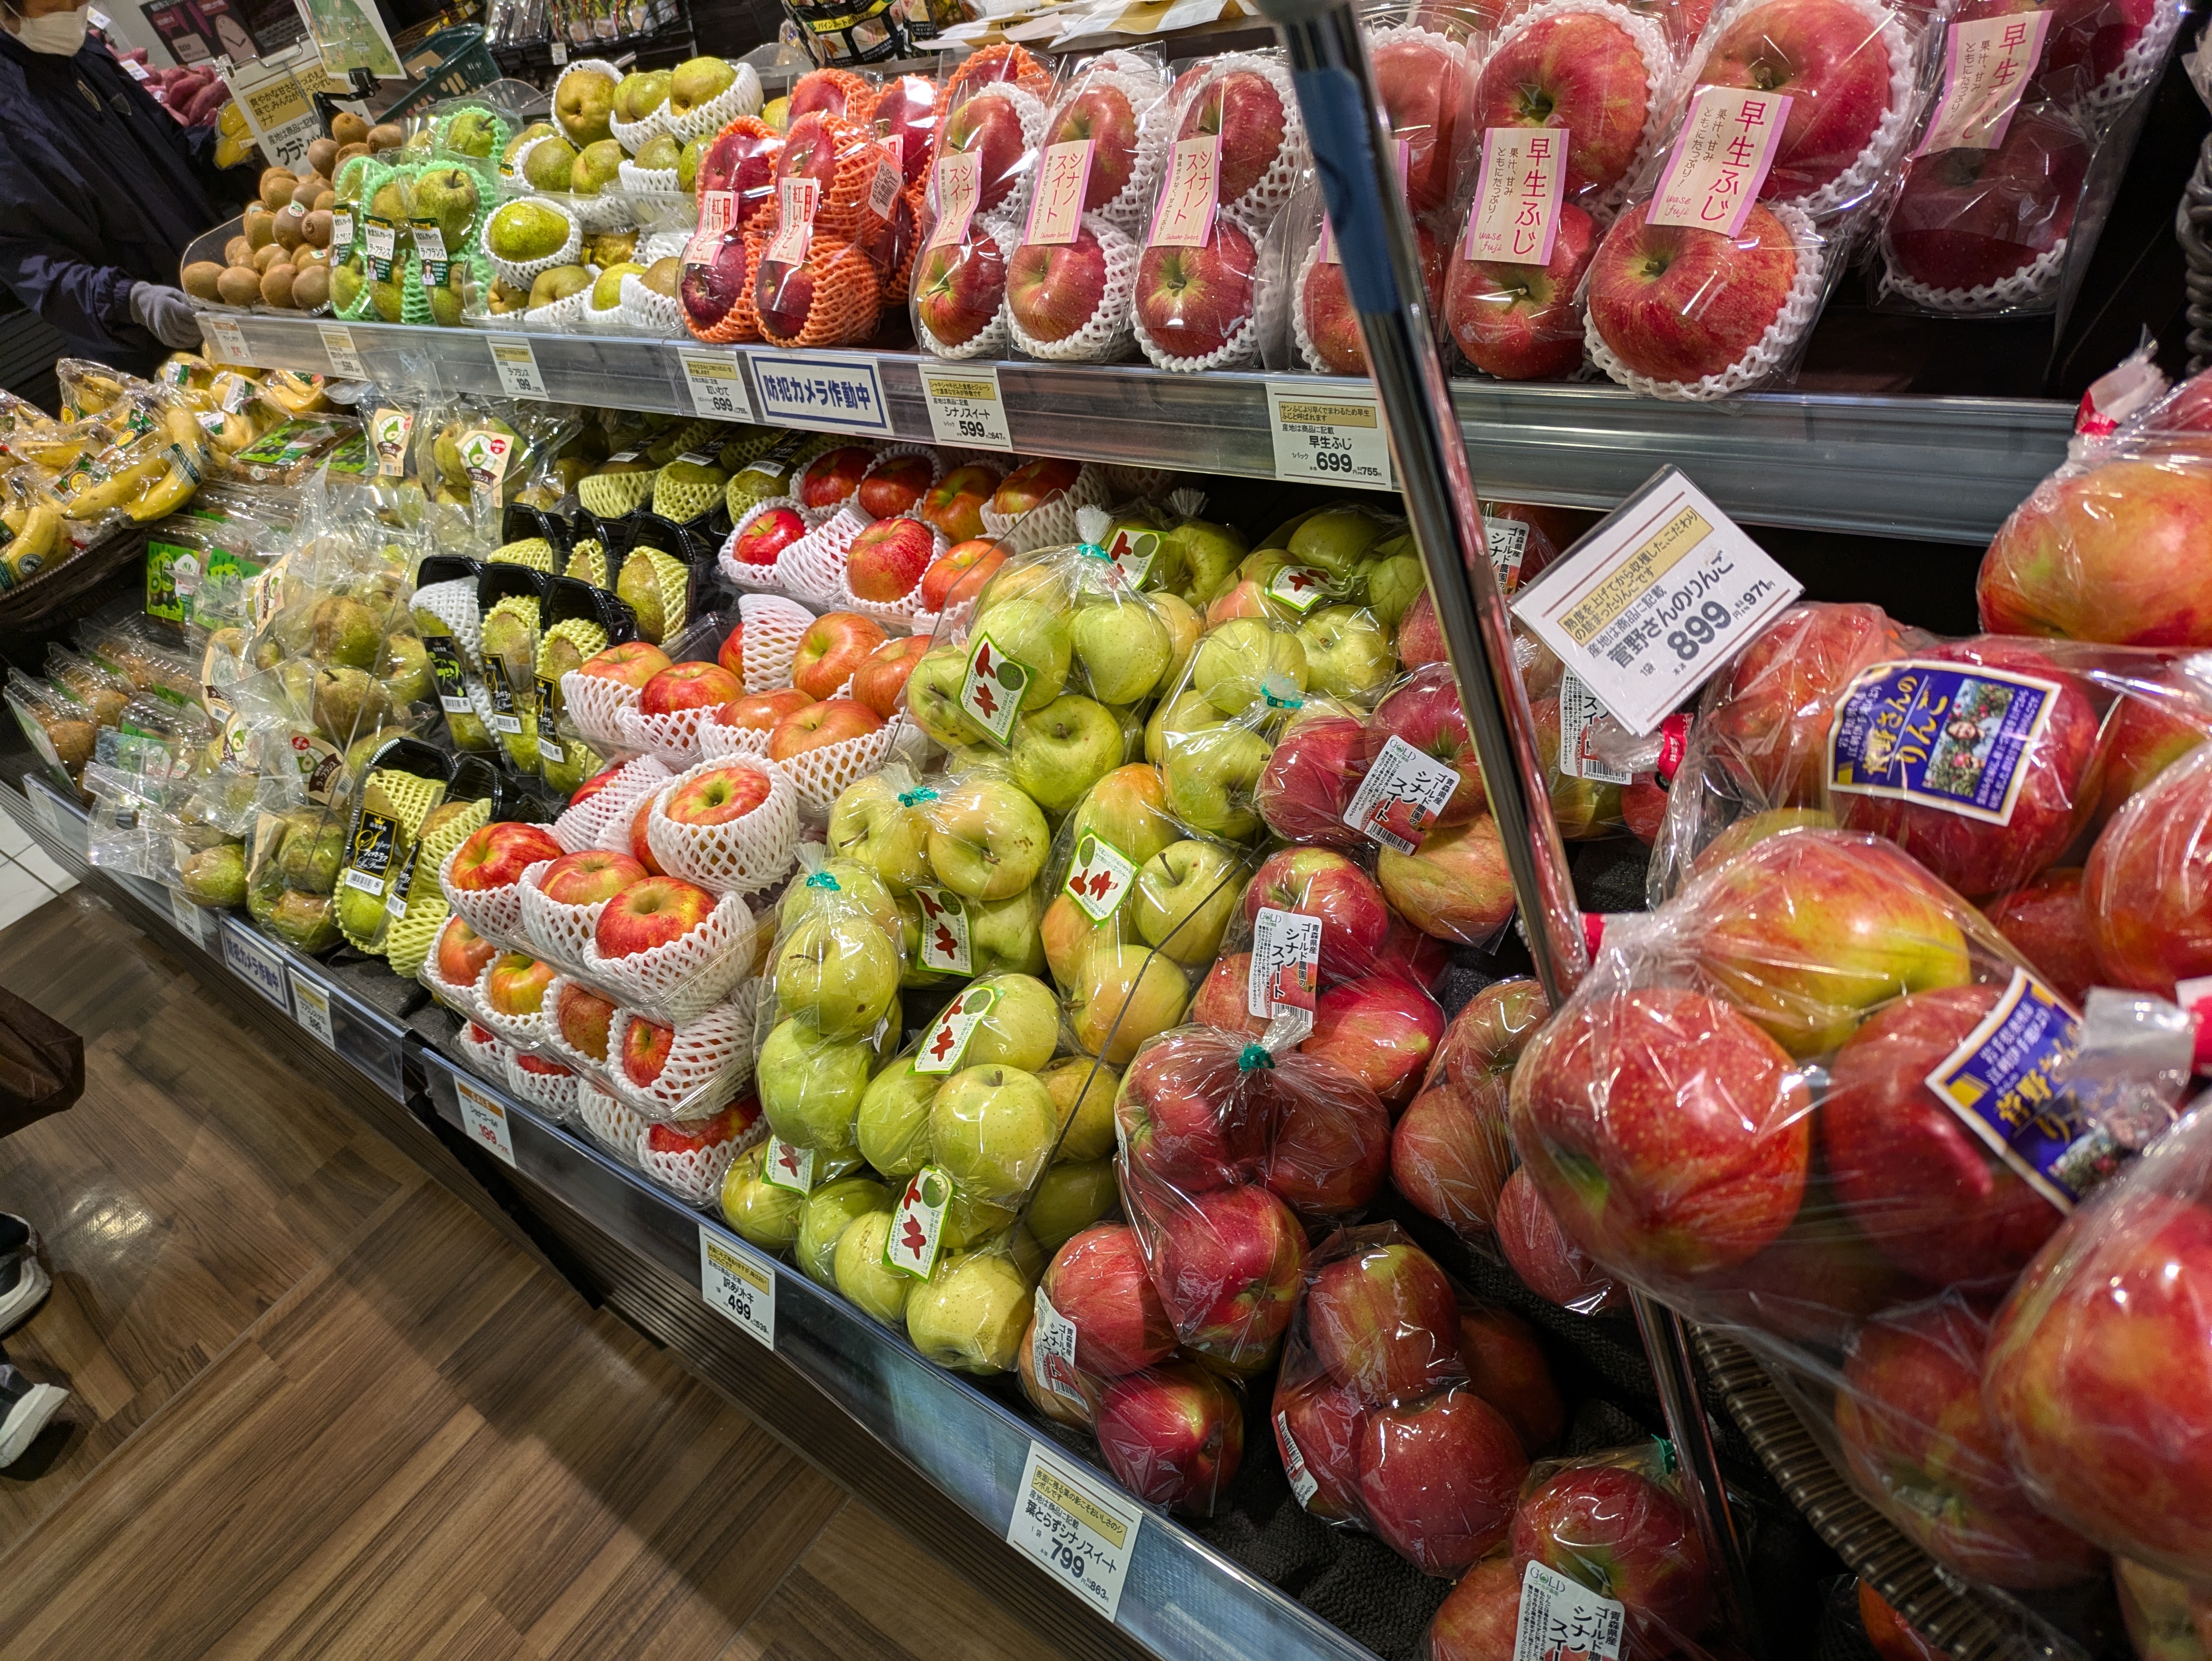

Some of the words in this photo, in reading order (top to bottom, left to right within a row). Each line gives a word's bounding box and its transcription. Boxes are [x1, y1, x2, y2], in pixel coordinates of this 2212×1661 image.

[1970, 40, 1991, 92] 果汁、甘み
[249, 68, 327, 107] 爽やかな甘さとっぱりした
[1703, 109, 1727, 163] 果汁、甘み
[1063, 153, 1084, 206] シナノ
[1194, 151, 1212, 208] シナノ
[1504, 147, 1519, 197] 果汁、甘み
[1701, 100, 1766, 221] 早生ふじ
[946, 168, 960, 231] スイート
[960, 166, 973, 215] シナノ
[1047, 155, 1067, 223] スイート
[1174, 154, 1198, 225] スイート
[1513, 138, 1551, 255] 早生ふじ
[1665, 194, 1691, 205] wase
[782, 185, 803, 249] 紅いわて
[1665, 204, 1689, 218] fuji
[1479, 232, 1502, 240] wase
[1480, 241, 1503, 253] fuji
[517, 378, 531, 391] 199
[706, 385, 730, 396] 紅いわて
[713, 397, 733, 412] 699
[762, 374, 870, 410] 防犯カメラ作動中
[930, 381, 991, 391] シャキシャキとした食感とジューシ
[933, 397, 969, 406] 産地は商品に記載
[944, 406, 991, 420] シナノスイート
[959, 420, 985, 438] 599
[1281, 404, 1371, 417] サンふじより早くでまわるため早生
[1282, 413, 1327, 422] ふじと呼ばれます
[1282, 423, 1335, 434] 産地は商品に記載
[1309, 435, 1352, 450] 早生ふじ
[1316, 452, 1352, 473] 699
[1489, 532, 1505, 568] シナノ
[1498, 527, 1519, 589] ゴールド農園の
[1512, 529, 1526, 558] 青森県産
[1563, 509, 1699, 633] 熟度を上げてから収穫した、こだわり
[1574, 568, 1655, 641] の詰まったりんごです
[1586, 585, 1668, 659] 産地は商品に記載
[1606, 550, 1735, 669] 菅野さんのりんご
[1666, 600, 1732, 661] 899
[1732, 610, 1743, 620] 円
[973, 642, 999, 720] トキ
[1640, 662, 1658, 677] 1袋
[1861, 675, 1917, 776] 菅野さんの
[1898, 689, 1949, 764] りんご
[1389, 739, 1416, 761] GOLD
[1375, 777, 1408, 822] スイート
[1402, 771, 1431, 804] シナノ
[1408, 773, 1448, 826] ゴールド農園の
[1433, 777, 1455, 806] 青森県産
[355, 830, 391, 851] Super
[1069, 868, 1119, 901] トキ
[916, 889, 958, 960] トキ
[1260, 911, 1282, 923] GOLD
[1285, 928, 1300, 968] シナノ
[1298, 923, 1312, 987] ゴールド農園の
[1308, 924, 1320, 954] 青森県産
[1271, 944, 1286, 999] スイート
[930, 994, 963, 1062] トキ
[479, 1123, 498, 1145] 199
[901, 1172, 927, 1261] トキ
[723, 1276, 754, 1304] 訳ありトキ
[728, 1294, 751, 1320] 499
[1029, 1488, 1080, 1530] 産地は商品に記載
[1033, 1477, 1063, 1502] ンボルです
[1035, 1469, 1123, 1534] 表面に残る葉の影こそおいしさのシ
[1025, 1499, 1117, 1574] 葉とらずシナノスイート
[1050, 1537, 1085, 1578] 799
[1530, 1566, 1566, 1593] GOLD
[1548, 1617, 1569, 1661] スイー
[1569, 1605, 1593, 1652] シナノ
[1588, 1606, 1610, 1661] ゴールド農
[1605, 1610, 1622, 1647] 青森県産
